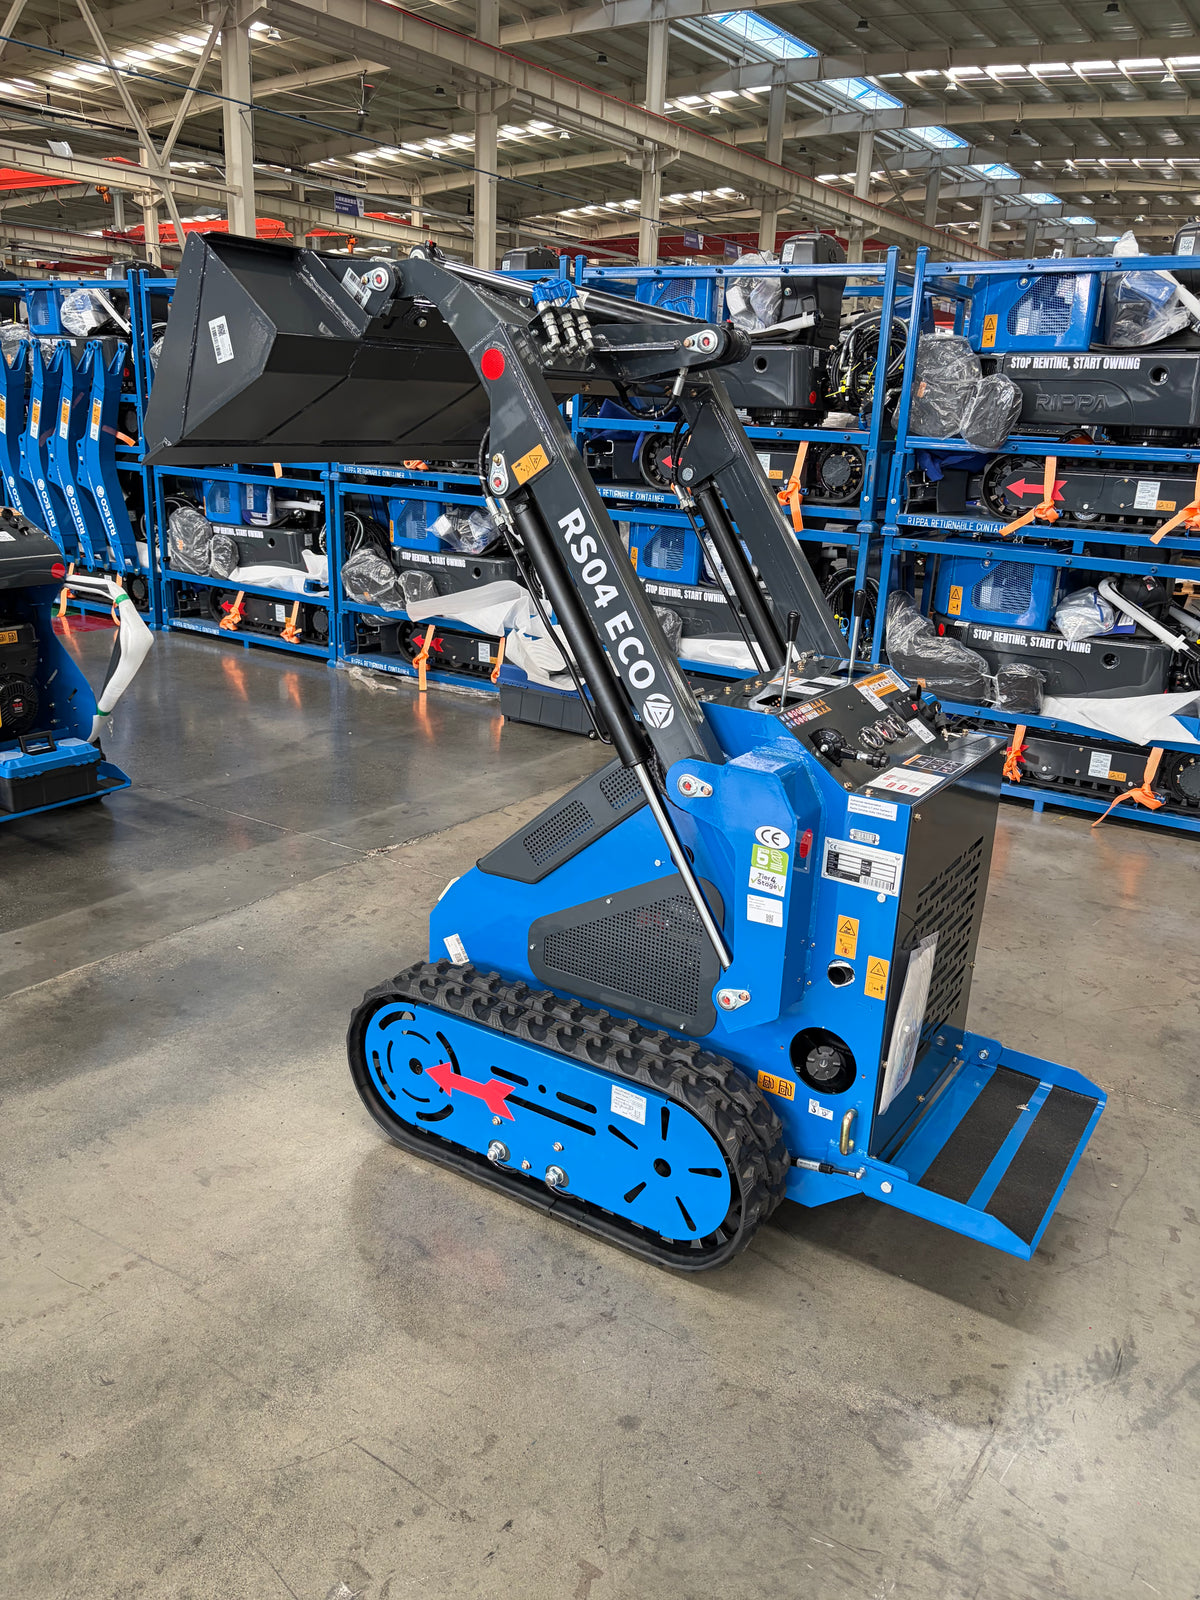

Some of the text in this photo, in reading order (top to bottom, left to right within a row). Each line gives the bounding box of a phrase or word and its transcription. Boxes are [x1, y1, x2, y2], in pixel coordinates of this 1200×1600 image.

[1010, 356, 1141, 370] STOP RENTING, START OWNING
[1035, 394, 1110, 413] RIPPA
[636, 493, 665, 502] CONTAINER
[42, 491, 56, 527] R10 ECO
[71, 498, 86, 534] R10 ECO
[101, 498, 117, 536] R10 ECO
[908, 517, 928, 527] RIPPA
[931, 519, 974, 530] RETURNABLE
[558, 507, 656, 689] RS04 ECO
[645, 584, 658, 594] STOP
[658, 586, 683, 599] RENTING,
[684, 590, 702, 600] START
[973, 628, 992, 640] STOP
[993, 632, 1028, 647] RENTING,
[1030, 636, 1056, 650] START
[761, 829, 781, 846] CE
[757, 878, 777, 890] Stage
[758, 872, 771, 881] Tier
